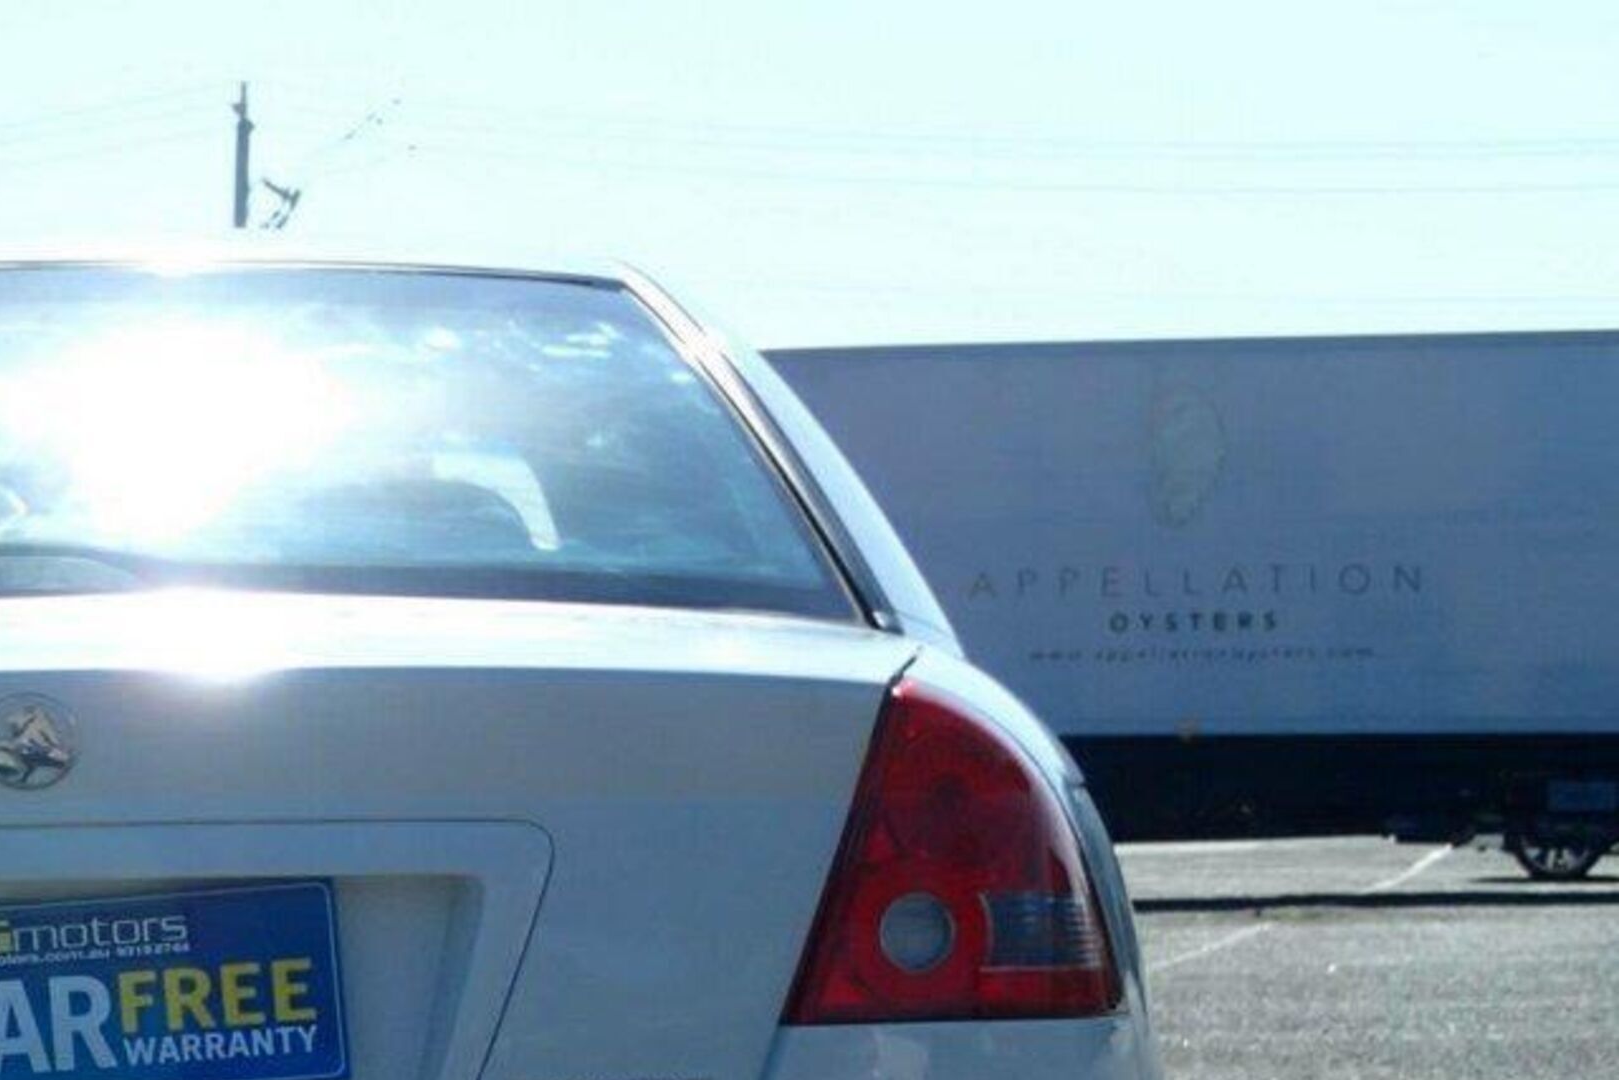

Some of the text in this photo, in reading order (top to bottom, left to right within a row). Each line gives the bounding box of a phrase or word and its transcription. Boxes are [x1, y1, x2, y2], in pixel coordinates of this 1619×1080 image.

[969, 563, 1424, 598] APPELLATION
[1108, 610, 1280, 634] OYSTERS
[118, 958, 319, 1034] FREE
[123, 1026, 319, 1067] WARRANTY
